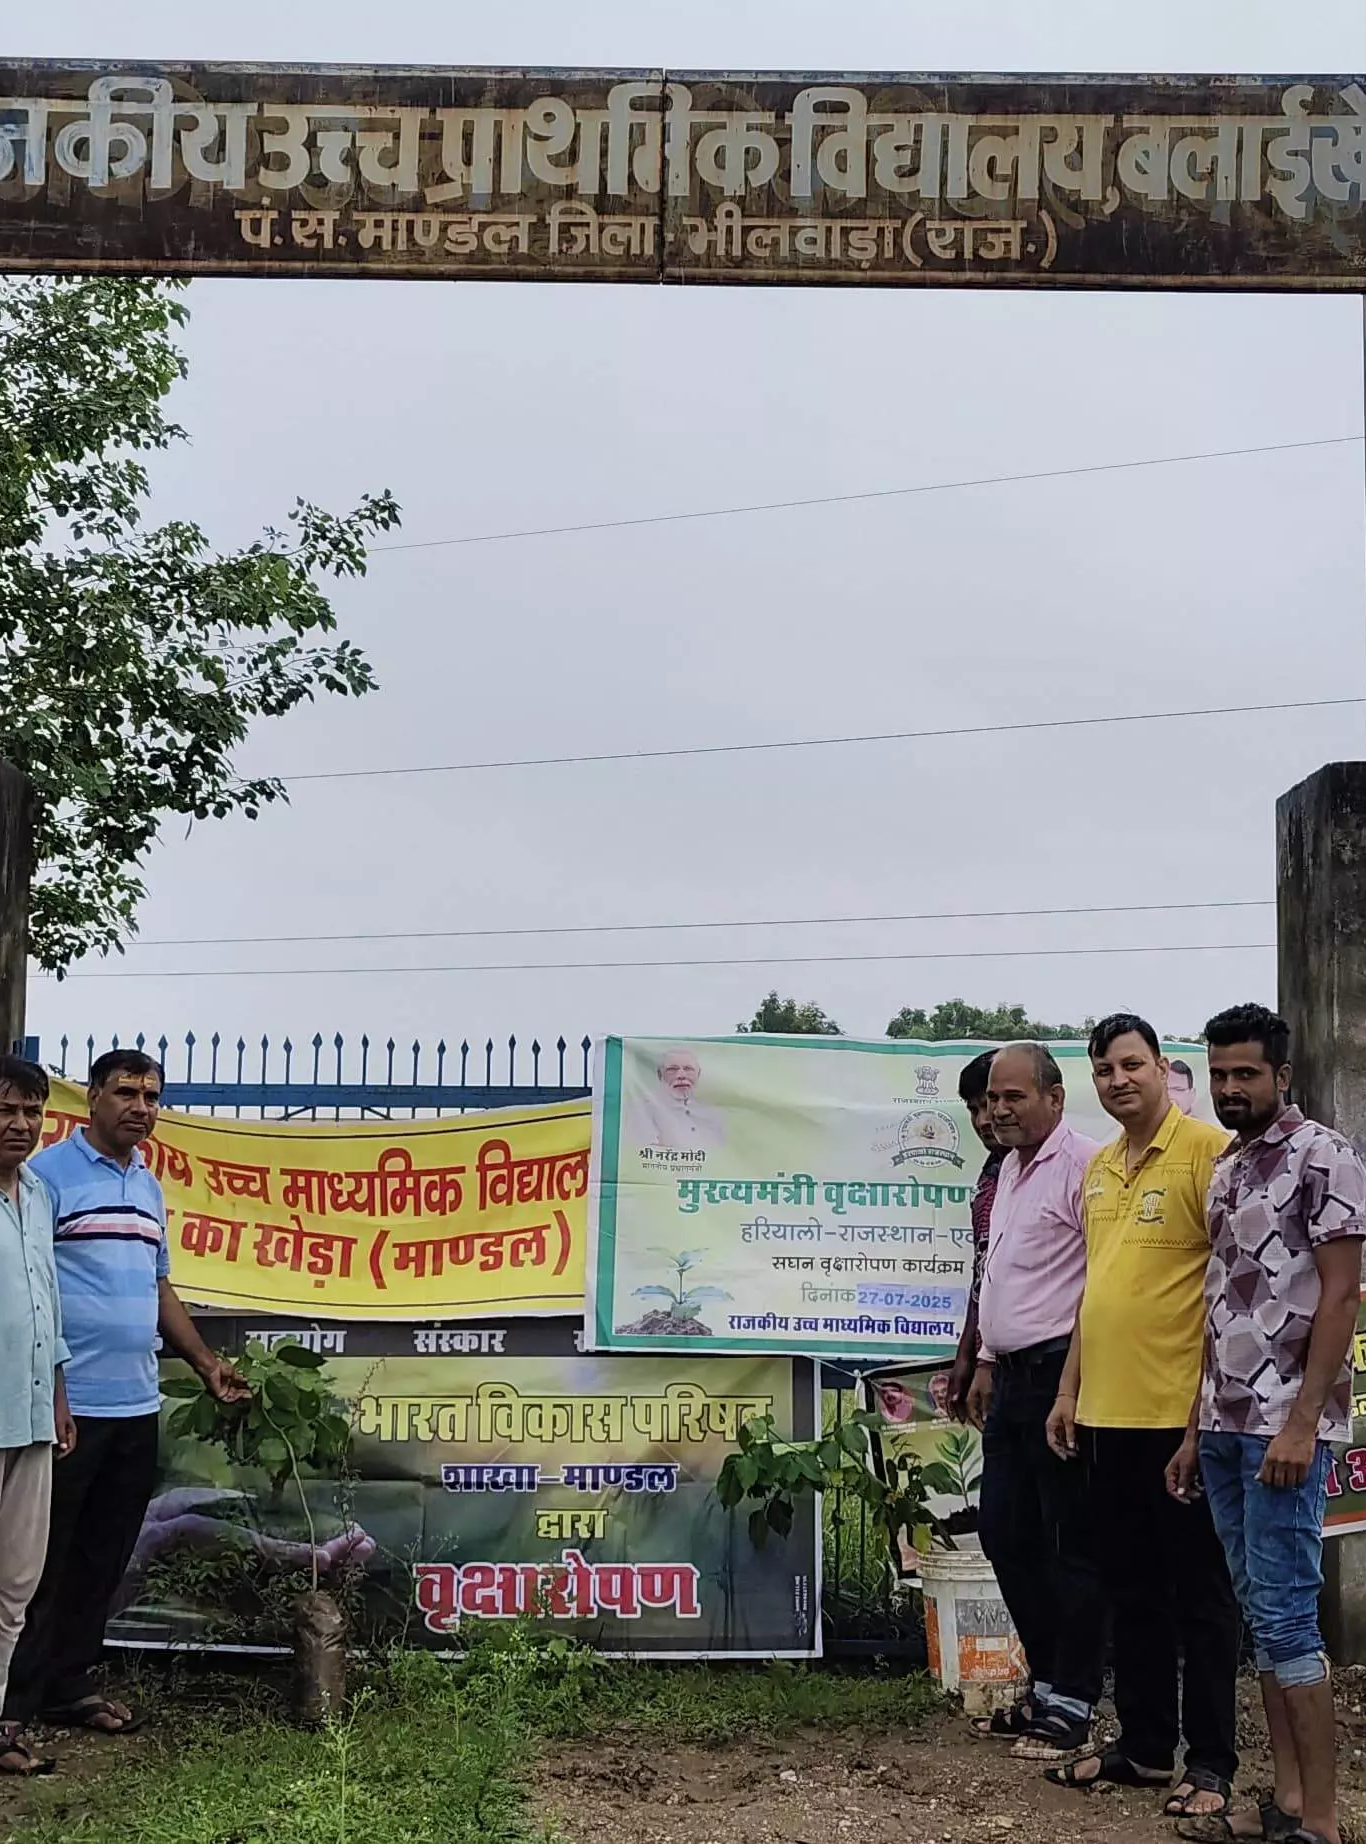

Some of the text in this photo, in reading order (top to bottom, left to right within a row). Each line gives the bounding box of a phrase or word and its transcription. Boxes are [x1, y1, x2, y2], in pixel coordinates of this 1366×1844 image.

[260, 103, 430, 192] उच्च
[425, 82, 780, 204] प्राथमिक
[353, 213, 537, 254] माण्डल
[638, 1147, 653, 1159] श्री
[680, 1149, 706, 1162] मोदी
[196, 1155, 272, 1205] उच्च
[280, 1147, 465, 1217] माध्यमिक
[475, 1138, 590, 1211] विद्याल
[676, 1171, 819, 1213] मुख्यमंत्री
[180, 1209, 571, 1289] का खेड़ा (माण्डल)
[772, 1252, 965, 1278] सघन वृक्षारोपण कार्यक्रम
[799, 1281, 952, 1309] दिनांक 27-07-2025
[413, 1322, 507, 1353] संस्कार
[728, 1312, 789, 1331] राजकीय
[793, 1316, 820, 1332] उच्च
[822, 1315, 892, 1334] माध्यमिक
[357, 1395, 473, 1443] भारत
[474, 1382, 627, 1444] विकास
[535, 1508, 609, 1540] द्वारा
[414, 1550, 701, 1634] वृक्षारोपण
